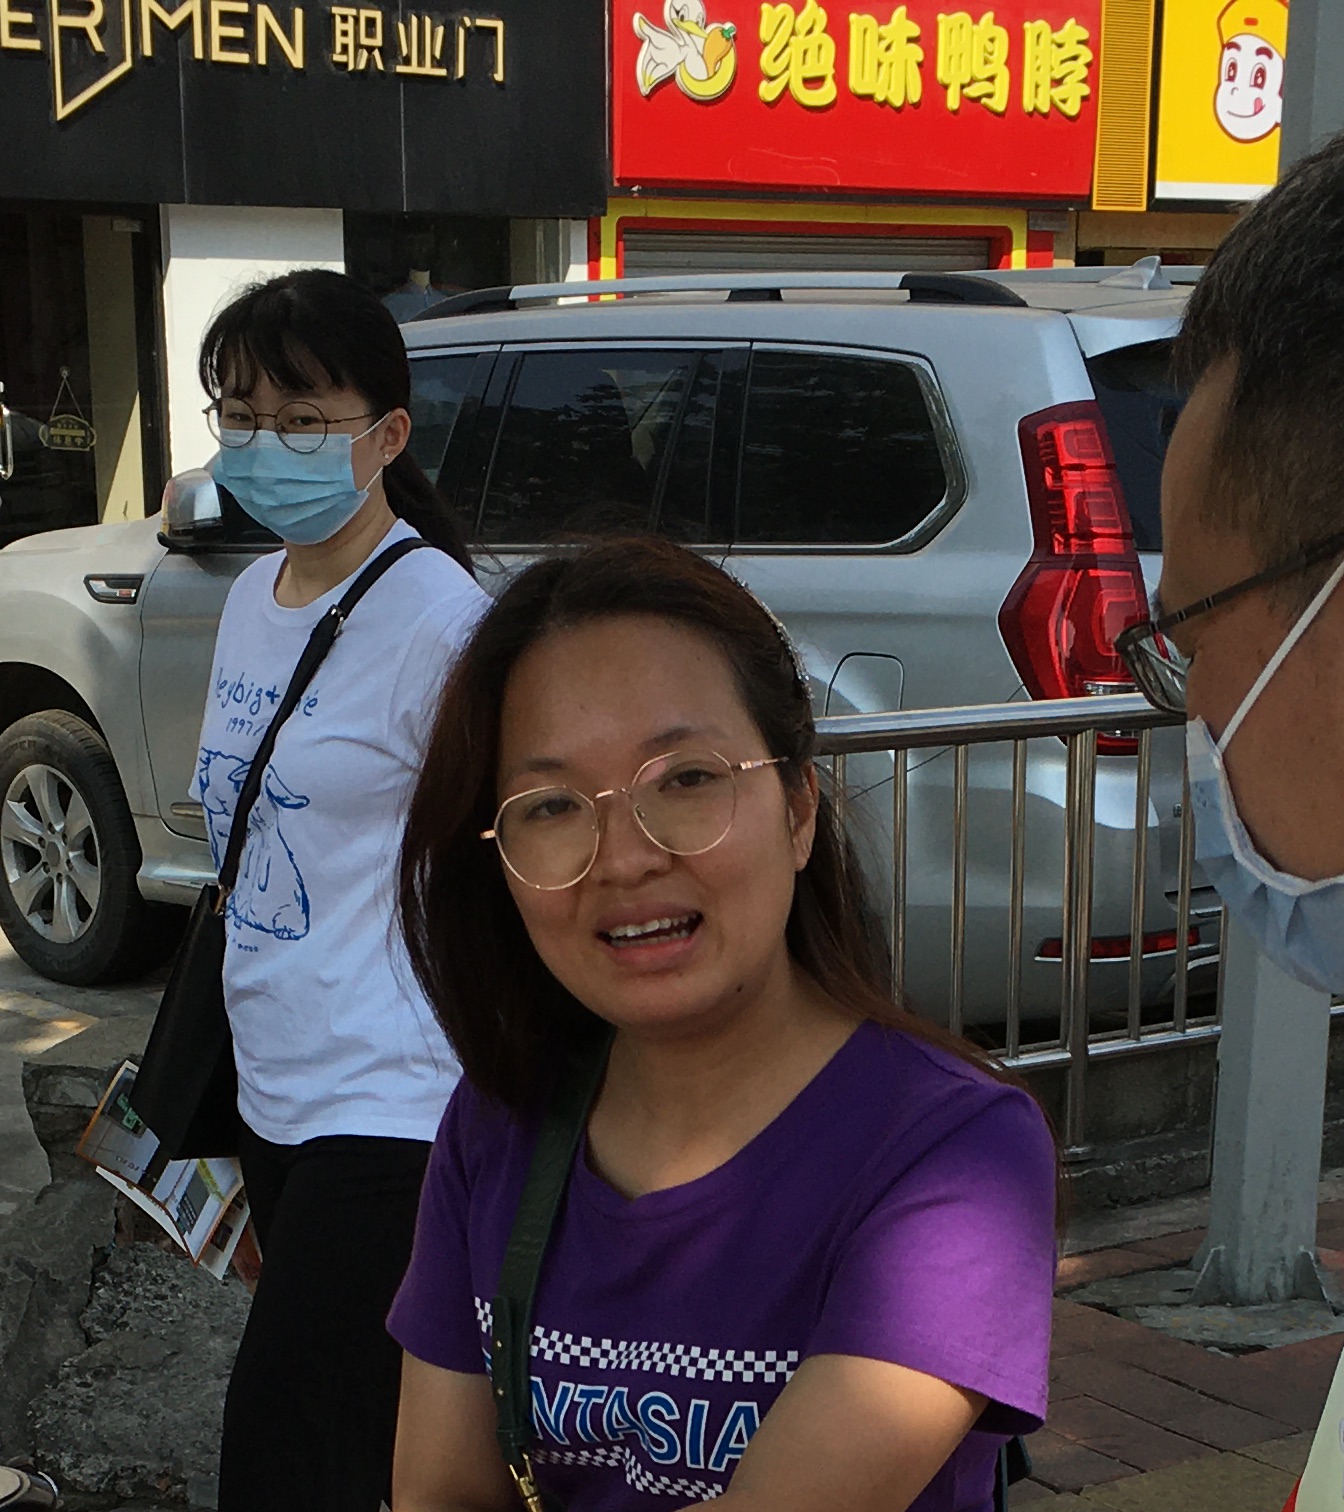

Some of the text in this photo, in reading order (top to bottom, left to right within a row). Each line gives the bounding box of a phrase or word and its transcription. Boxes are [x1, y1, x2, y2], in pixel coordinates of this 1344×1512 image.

[140, 0, 306, 70] MEN
[331, 6, 506, 82] 职业门
[758, 0, 1093, 117] 绝味鸭脖
